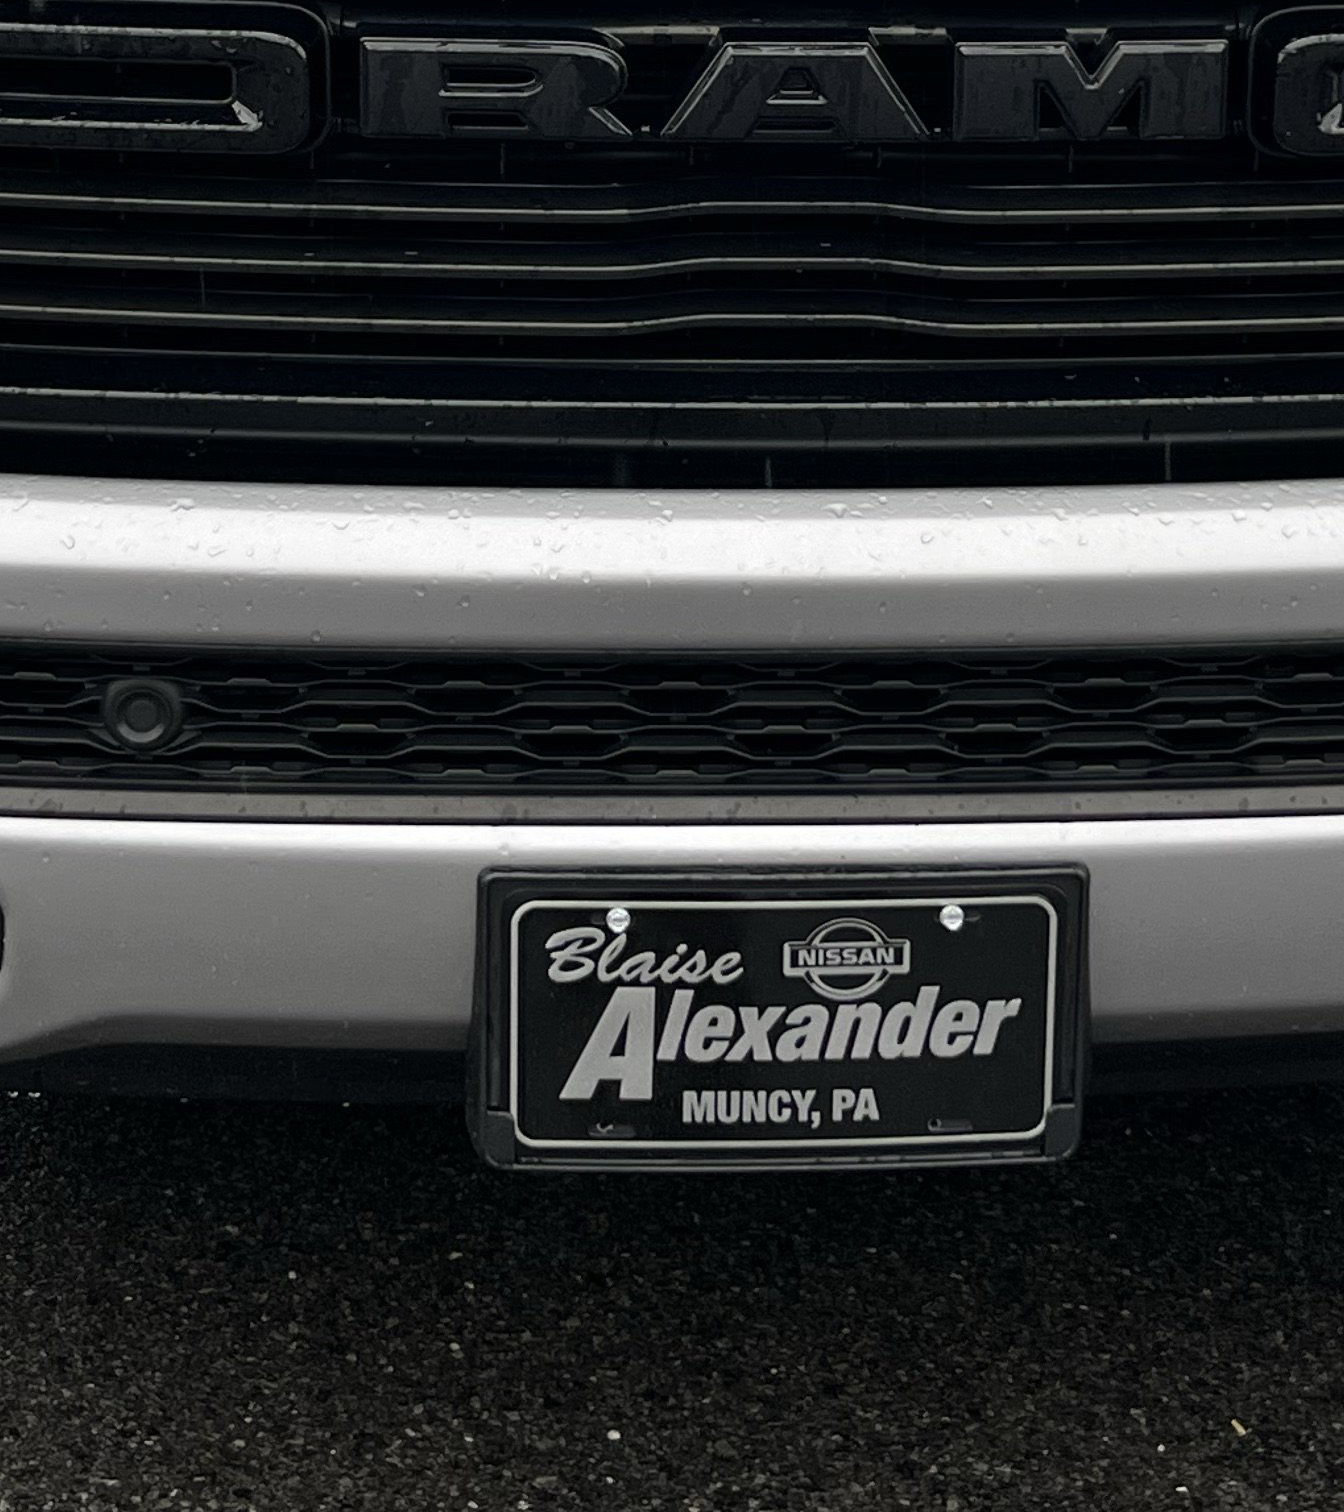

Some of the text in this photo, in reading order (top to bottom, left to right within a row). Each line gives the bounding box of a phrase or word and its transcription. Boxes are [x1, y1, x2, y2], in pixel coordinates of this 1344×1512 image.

[358, 37, 1231, 142] RAM
[545, 926, 744, 984] Blaise
[798, 947, 895, 966] NISSAN
[559, 986, 1022, 1100] Alexander
[682, 1088, 880, 1129] MUNCY, PA
